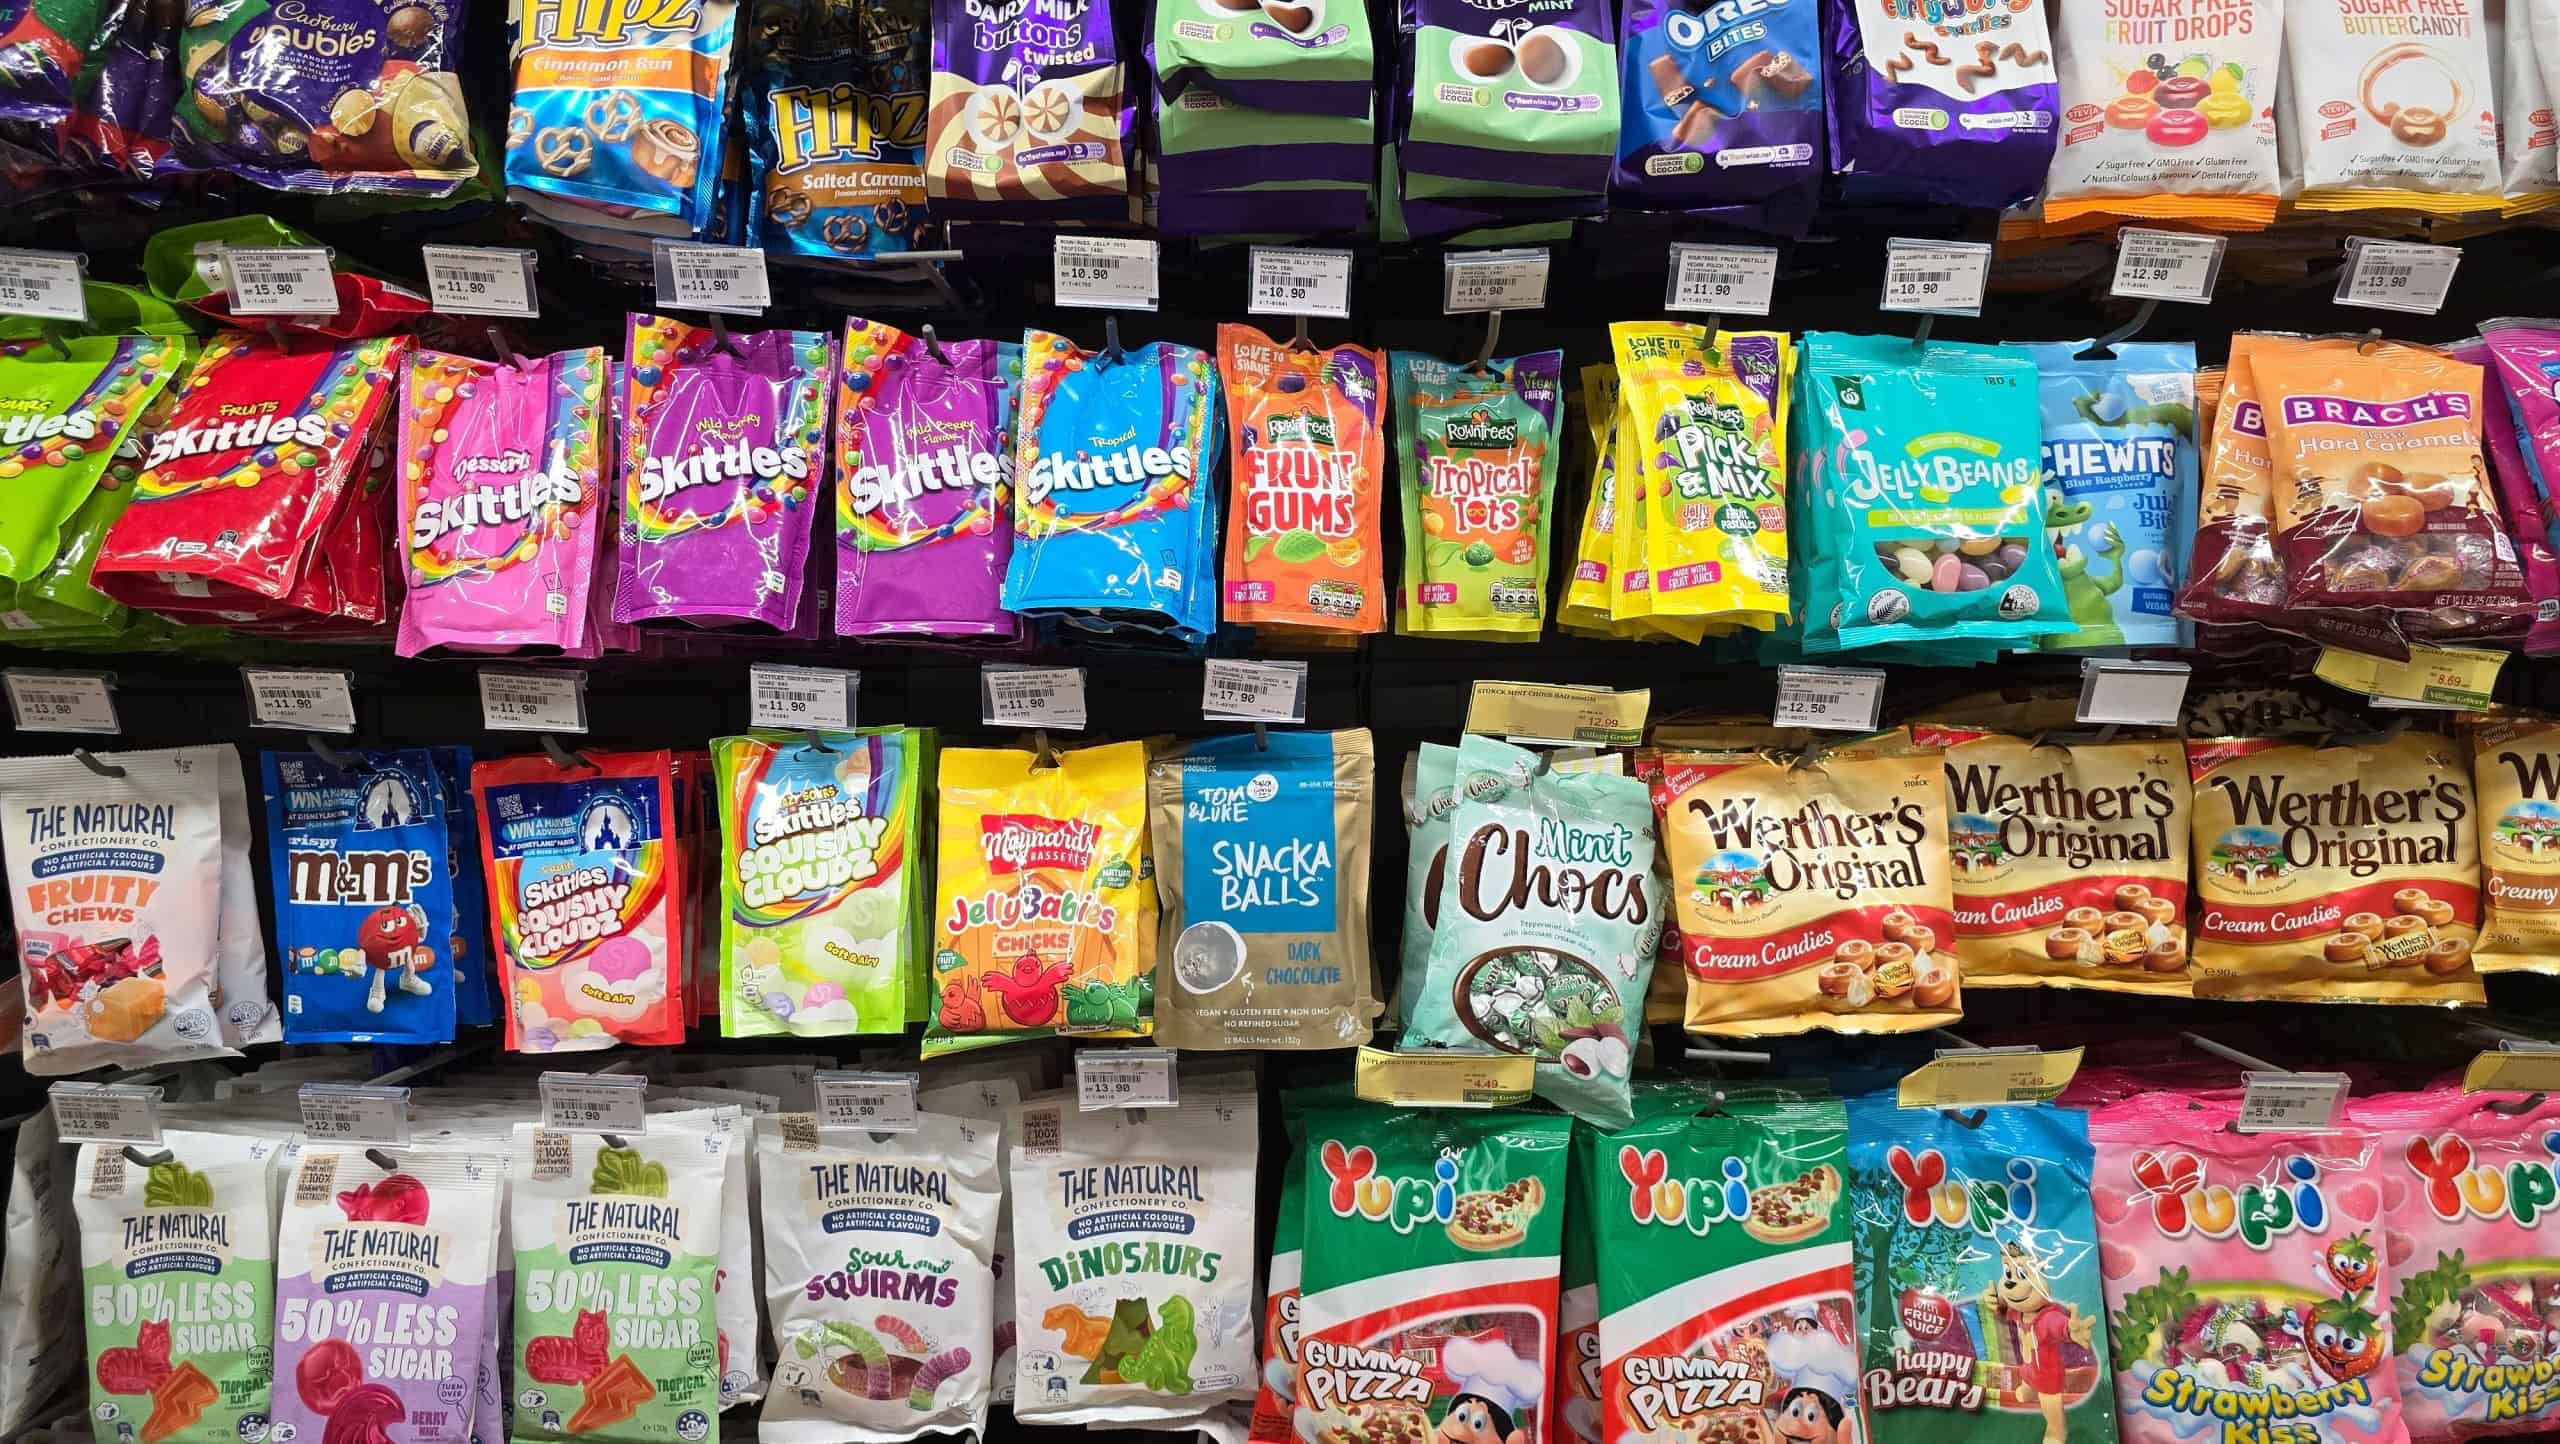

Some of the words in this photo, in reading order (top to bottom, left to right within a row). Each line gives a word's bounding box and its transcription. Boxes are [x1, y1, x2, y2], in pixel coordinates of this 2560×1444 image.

[275, 0, 358, 33] Cadbury
[965, 0, 1025, 24] DAIRY
[1036, 0, 1089, 21] MILK
[1527, 0, 1575, 14] MINT
[2340, 0, 2410, 15] SUGAR
[2416, 0, 2469, 15] FREE
[974, 18, 1081, 51] buttons
[2105, 19, 2166, 44] FRUIT
[2174, 11, 2253, 41] DROPS
[1711, 23, 1764, 56] BITES
[1024, 42, 1095, 65] twisted
[532, 56, 628, 73] Cinnamon
[635, 57, 673, 72] Bun
[768, 82, 927, 175] Flipz
[801, 173, 856, 190] Salted
[859, 171, 925, 188] Caramel
[1071, 267, 1109, 280] 10.90
[2132, 269, 2168, 280] 12.90
[2368, 277, 2407, 288] 13.90
[2, 287, 40, 301] 15.90
[254, 282, 294, 296] 15.90
[447, 281, 486, 294] 11.90
[691, 280, 729, 292] 11.90
[1269, 286, 1306, 300] 10.90
[1467, 286, 1504, 296] 10.90
[1692, 284, 1731, 296] 11.90
[1900, 283, 1938, 294] 10.90
[1628, 337, 1665, 350] LOVE
[1667, 339, 1680, 348] TO
[1237, 360, 1270, 376] SHARE
[1409, 361, 1444, 373] LOVE
[1412, 372, 1448, 384] SHARE
[219, 401, 279, 417] FRUITS
[144, 414, 327, 470] Skittles
[1088, 426, 1136, 448] Tropical
[1678, 425, 1757, 469] Pick
[2300, 436, 2359, 453] Hard
[2365, 431, 2481, 451] Caramels
[639, 437, 808, 500] Skittles
[1027, 446, 1192, 504] Skittles
[1249, 451, 1354, 489] FRUIT
[1433, 458, 1531, 498] Tropical
[1677, 471, 1705, 497] &
[1706, 464, 1773, 499] Mix
[2065, 476, 2092, 489] Blue
[2095, 473, 2155, 489] Raspberry
[413, 469, 583, 548] Skittles
[1248, 493, 1354, 533] GUMS
[1456, 500, 1519, 532] Tots
[2437, 673, 2461, 687] 8.69
[274, 699, 312, 709] 11.90
[769, 701, 806, 713] 11.90
[1010, 698, 1045, 710] 11.90
[1220, 690, 1255, 703] 17.90
[34, 704, 72, 715] 13.90
[500, 704, 537, 715] 11.90
[1788, 702, 1826, 715] 12.50
[1588, 718, 1618, 727] 12.99
[1198, 786, 1245, 805] TOM
[1945, 762, 2175, 821] Werther's
[2211, 773, 2466, 826] Werther's
[1189, 802, 1200, 819] &
[1200, 802, 1249, 823] LUKE
[26, 805, 66, 844] THE
[73, 803, 175, 841] NATURAL
[1688, 798, 1927, 852] Werther's
[1535, 816, 1632, 868] Mint
[1999, 814, 2170, 869] Original
[2282, 821, 2458, 877] Original
[42, 866, 57, 874] NO
[60, 860, 107, 870] ARTIFICIAL
[110, 860, 155, 870] FLAVOURS
[44, 857, 59, 865] NO
[61, 852, 110, 863] ARTIFICIAL
[113, 852, 155, 862] COLOURS
[1212, 838, 1331, 880] SNACKA
[742, 854, 878, 908] CLOUDZ
[1764, 844, 1927, 901] Original
[27, 875, 160, 913] FRUITY
[526, 867, 607, 908] Skittles
[1222, 875, 1320, 912] BALLS
[2487, 876, 2558, 905] Creamy
[47, 907, 134, 925] CHEWS
[2205, 912, 2267, 933] Cream
[2270, 906, 2341, 932] Candies
[520, 908, 622, 957] CLOUDZ
[996, 933, 1071, 951] CHICKS
[1287, 942, 1321, 962] DARK
[1694, 945, 1758, 969] Cream
[1760, 928, 1835, 964] Candies
[1265, 967, 1341, 985] CHOCOLATE
[1230, 1008, 1261, 1016] GLUTEN
[1263, 1008, 1280, 1016] FREE
[1290, 1008, 1309, 1016] NON
[1272, 1019, 1298, 1027] SUGAR
[1094, 1082, 1131, 1093] 13.90
[1473, 1079, 1498, 1088] 4.49
[564, 1110, 600, 1121] 13.90
[839, 1105, 874, 1117] 13.90
[2255, 1108, 2285, 1118] 5.00
[72, 1119, 110, 1132] 12.90
[314, 1121, 351, 1132] 12.90
[810, 1164, 849, 1200] THE
[856, 1161, 952, 1205] NATURAL
[1058, 1167, 1098, 1208] THE
[1104, 1164, 1205, 1202] NATURAL
[1321, 1139, 1460, 1234] Yupi
[1618, 1144, 1752, 1238] Yupi
[1887, 1145, 2037, 1237] Yupi
[828, 1197, 914, 1209] CONFECTIONERY
[918, 1201, 935, 1211] CO.
[2129, 1151, 2329, 1252] Yupi
[567, 1202, 598, 1234] THE
[602, 1202, 680, 1240] NATURAL
[846, 1212, 887, 1220] ARTIFICIAL
[889, 1213, 930, 1224] COLOURS
[846, 1220, 885, 1229] ARTIFICIAL
[887, 1221, 930, 1233] FLAVOURS
[1077, 1226, 1091, 1236] NO
[1093, 1221, 1140, 1233] ARTIFICIAL
[1142, 1221, 1186, 1231] FLAVOURS
[1078, 1218, 1092, 1228] NO
[1094, 1212, 1142, 1225] ARTIFICIAL
[1144, 1213, 1185, 1223] COLOURS
[123, 1216, 154, 1249] THE
[159, 1212, 229, 1247] NATURAL
[323, 1230, 357, 1263] THE
[362, 1229, 440, 1269] NATURAL
[346, 1281, 387, 1289] ARTIFICIAL
[389, 1282, 423, 1293] FLAVOURS
[348, 1273, 389, 1281] ARTIFICIAL
[391, 1274, 422, 1286] COLOURS
[806, 1268, 959, 1308] SQUIRMS
[92, 1284, 175, 1327] 50%
[179, 1279, 256, 1323] LESS
[526, 1269, 614, 1316] 50%
[618, 1272, 703, 1315] LESS
[280, 1297, 372, 1345] 50%
[374, 1299, 459, 1347] LESS
[1903, 1308, 1947, 1325] FRUIT
[1905, 1318, 1944, 1334] JUICE
[175, 1322, 256, 1354] SUGAR
[614, 1319, 701, 1349] SUGAR
[368, 1347, 453, 1381] SUGAR
[1304, 1341, 1426, 1376] GUMMI
[1895, 1350, 1975, 1375] happy
[1626, 1356, 1751, 1386] GUMMI
[441, 1382, 464, 1392] TURN
[442, 1390, 463, 1399] OVER
[1307, 1366, 1434, 1410] PIZZA
[1864, 1367, 1986, 1411] Bears
[2143, 1368, 2372, 1420] Strawberry
[1629, 1378, 1765, 1432] PIZZA
[411, 1411, 448, 1426] BERRY
